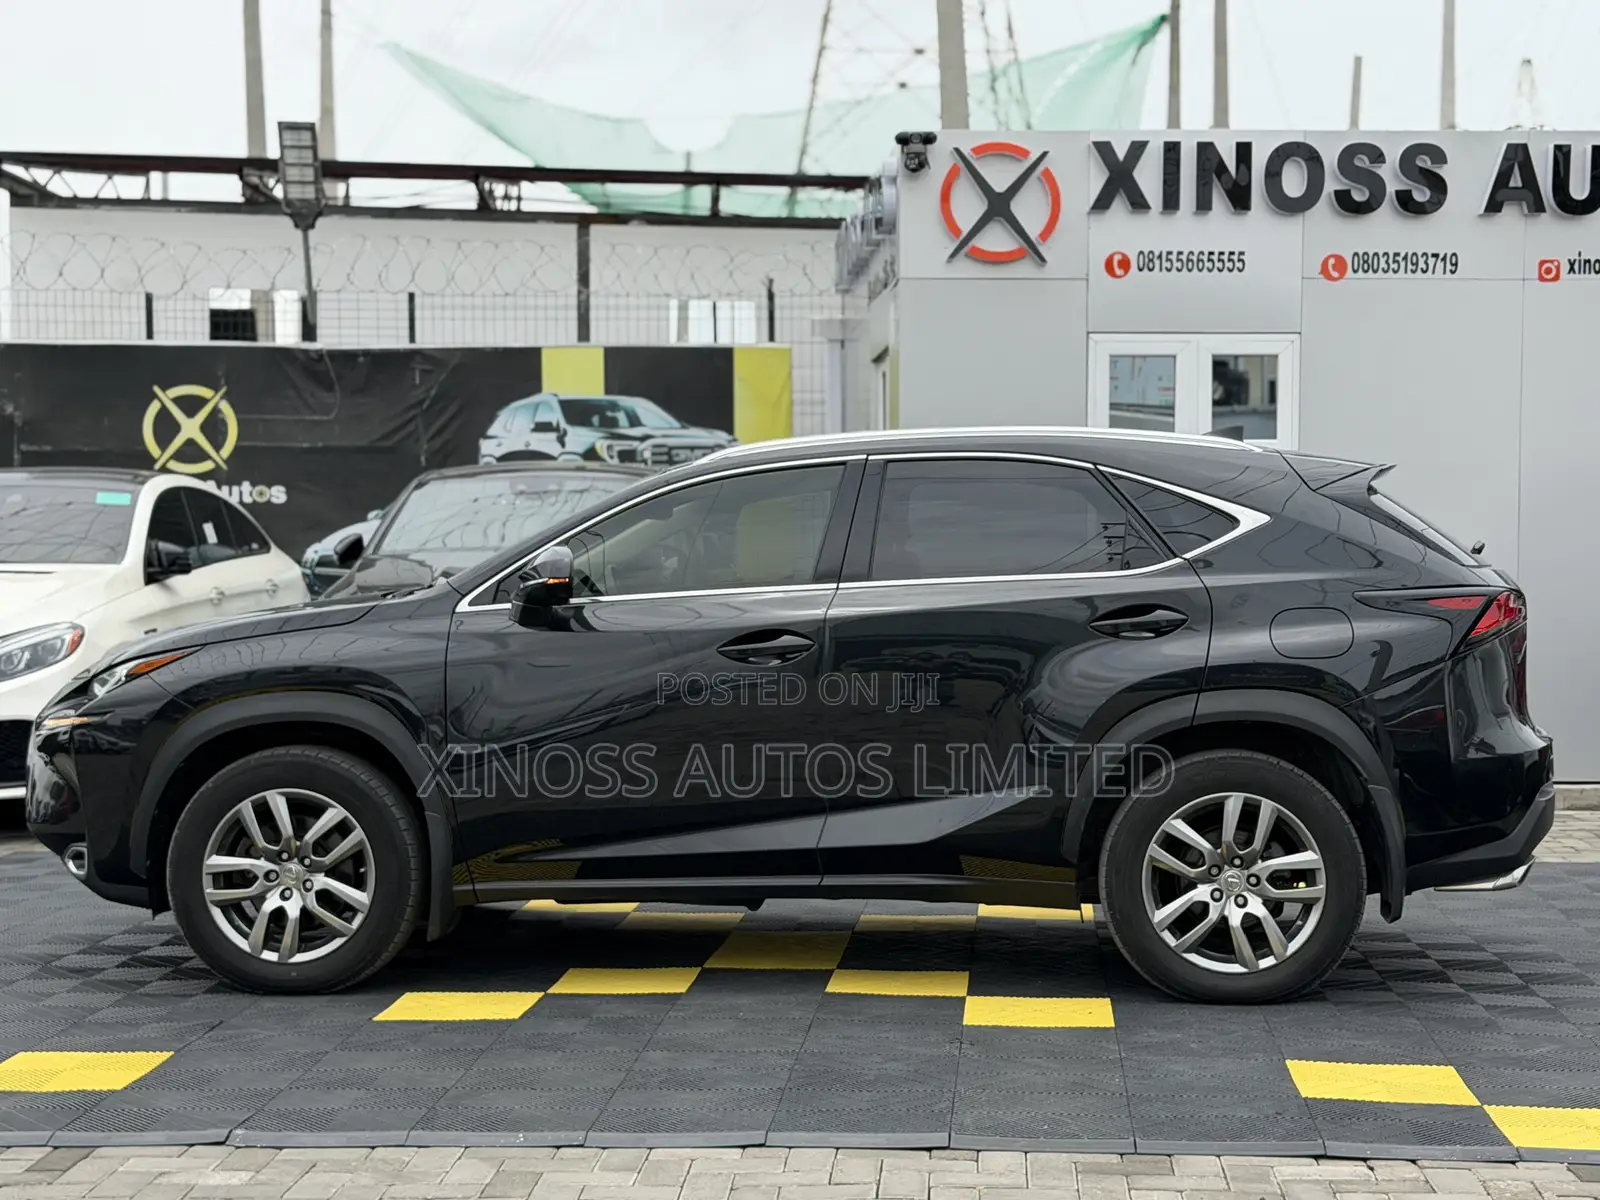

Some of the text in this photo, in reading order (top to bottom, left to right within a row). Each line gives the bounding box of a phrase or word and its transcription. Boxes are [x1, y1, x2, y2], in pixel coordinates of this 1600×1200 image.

[1089, 140, 1600, 217] XINOSS AU
[1136, 250, 1247, 273] 08155665555
[1351, 251, 1459, 275] 08035193719
